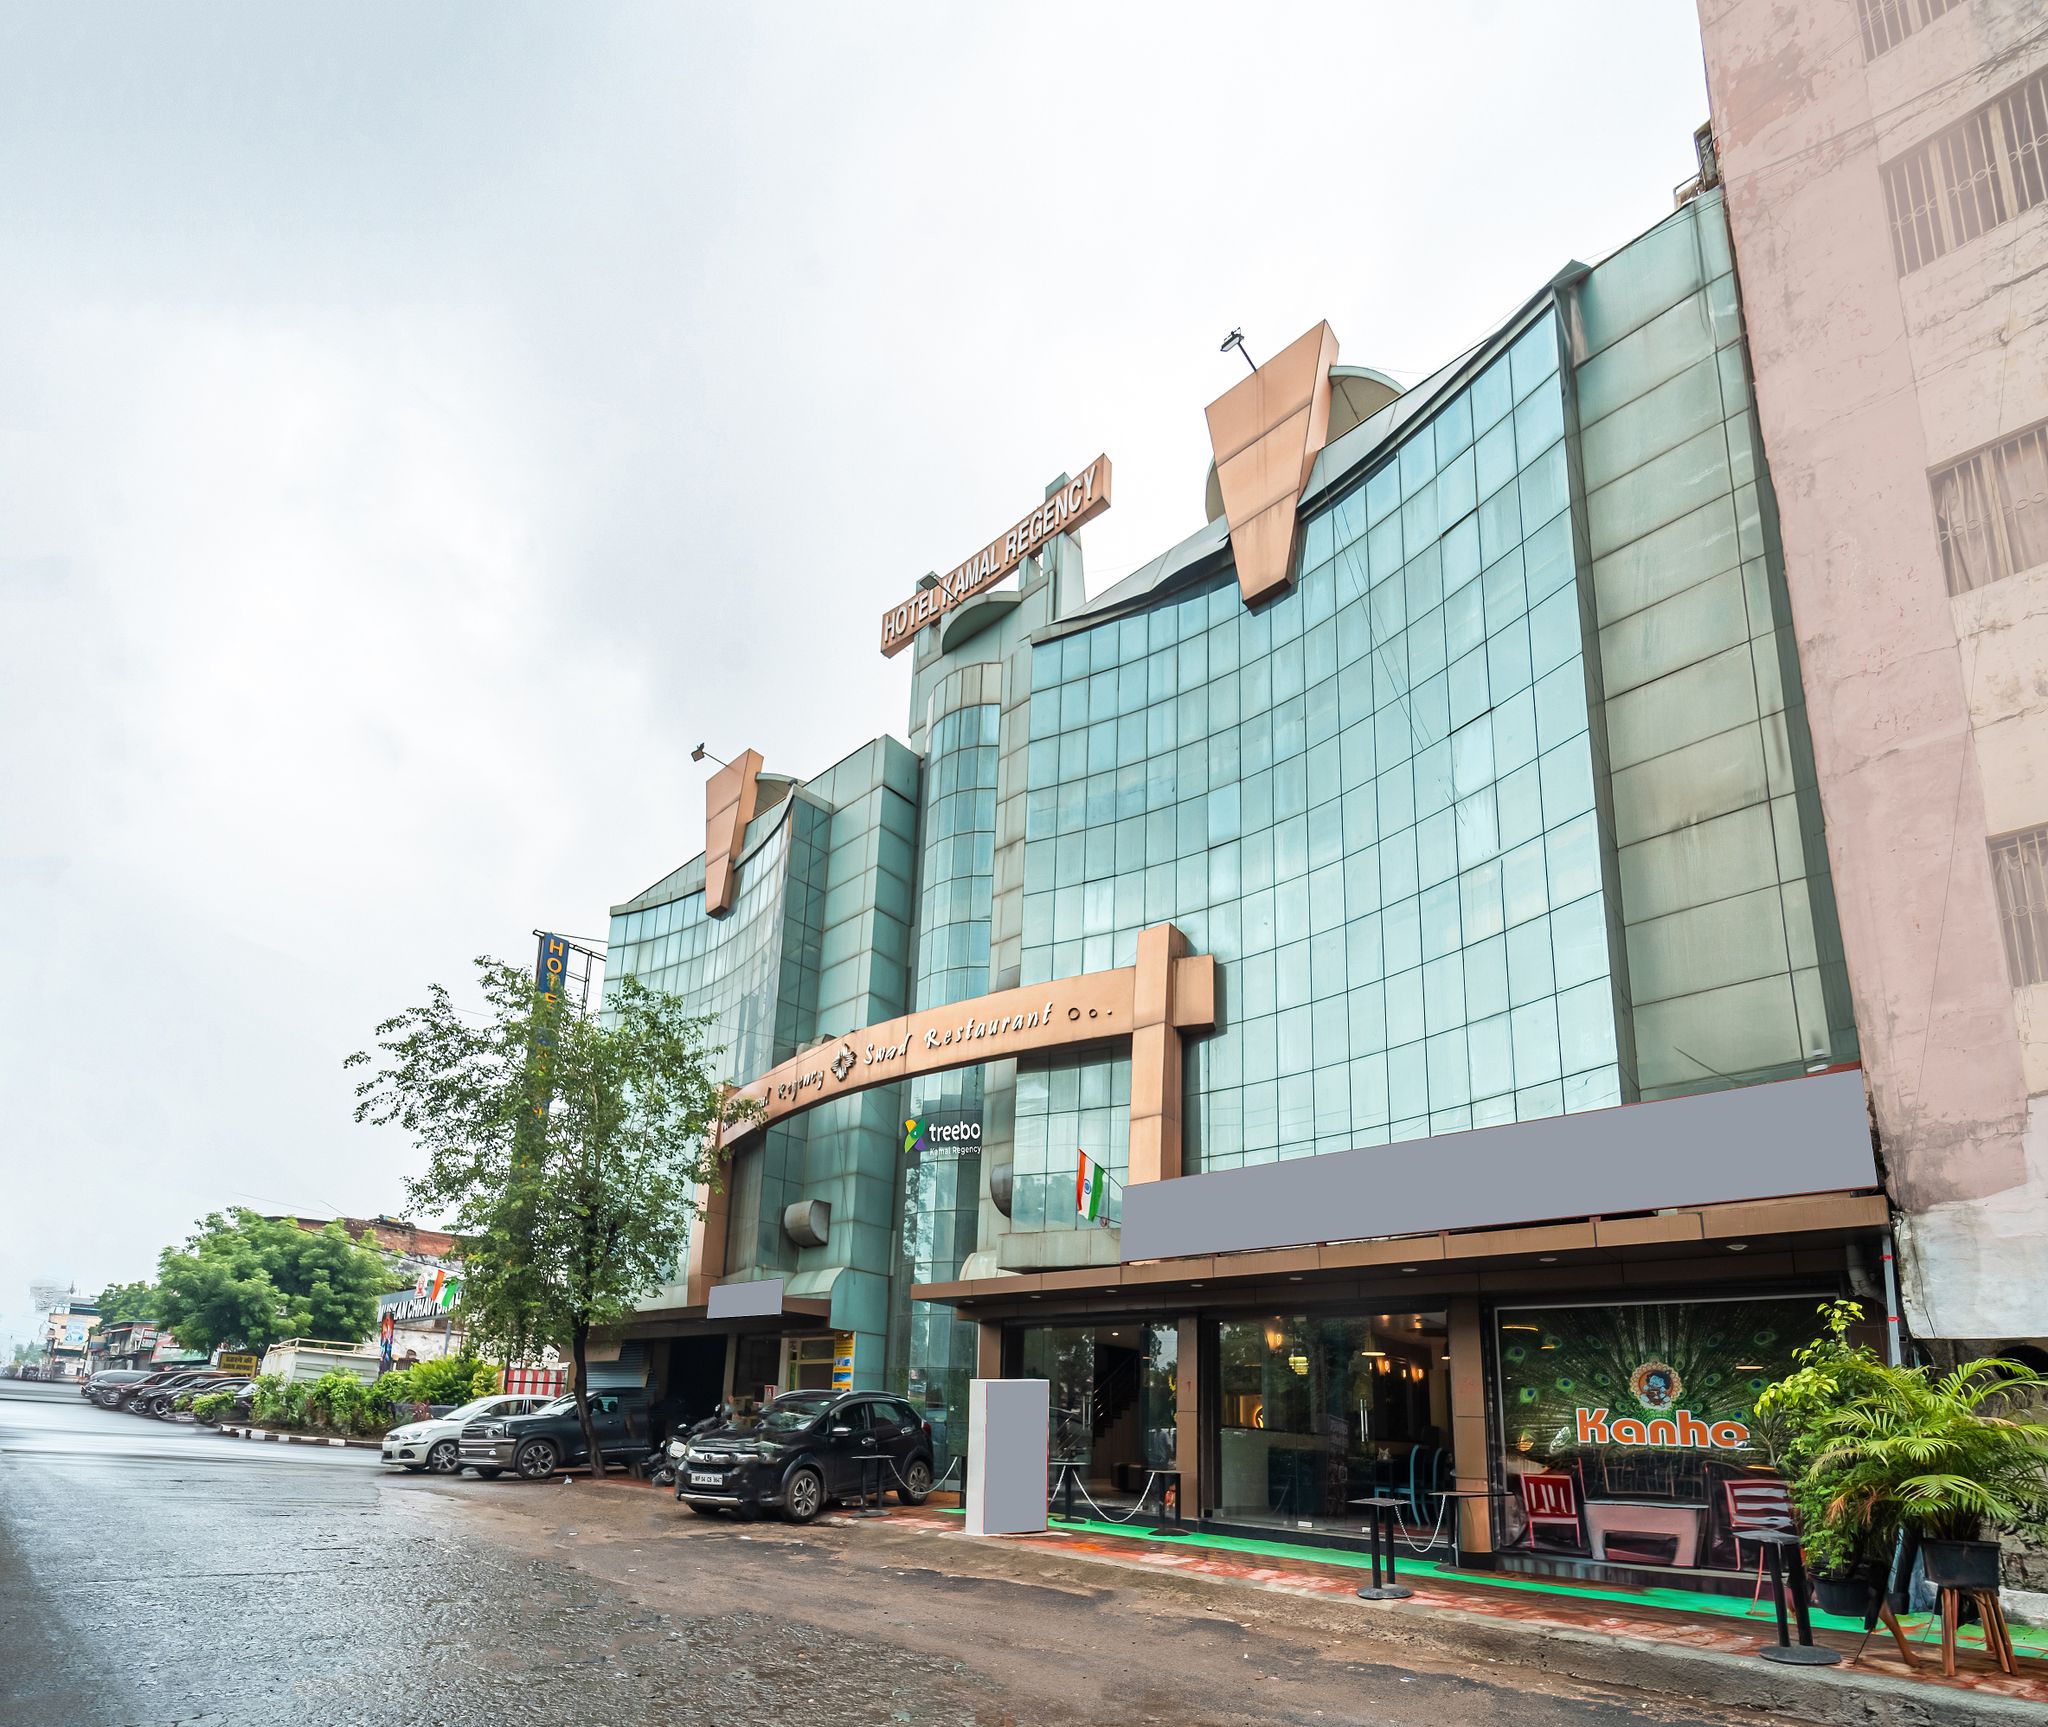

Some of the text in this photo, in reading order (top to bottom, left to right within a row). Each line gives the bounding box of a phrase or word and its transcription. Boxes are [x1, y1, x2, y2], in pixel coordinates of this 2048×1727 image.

[884, 464, 1097, 643] HOTEL KAMAL REGENCY
[544, 938, 565, 1009] HOTE
[863, 1000, 1053, 1066] Swad Restaurant
[928, 1120, 981, 1142] treebo
[929, 1145, 982, 1157] Kamal Regency
[1576, 1408, 1750, 1448] Kanha
